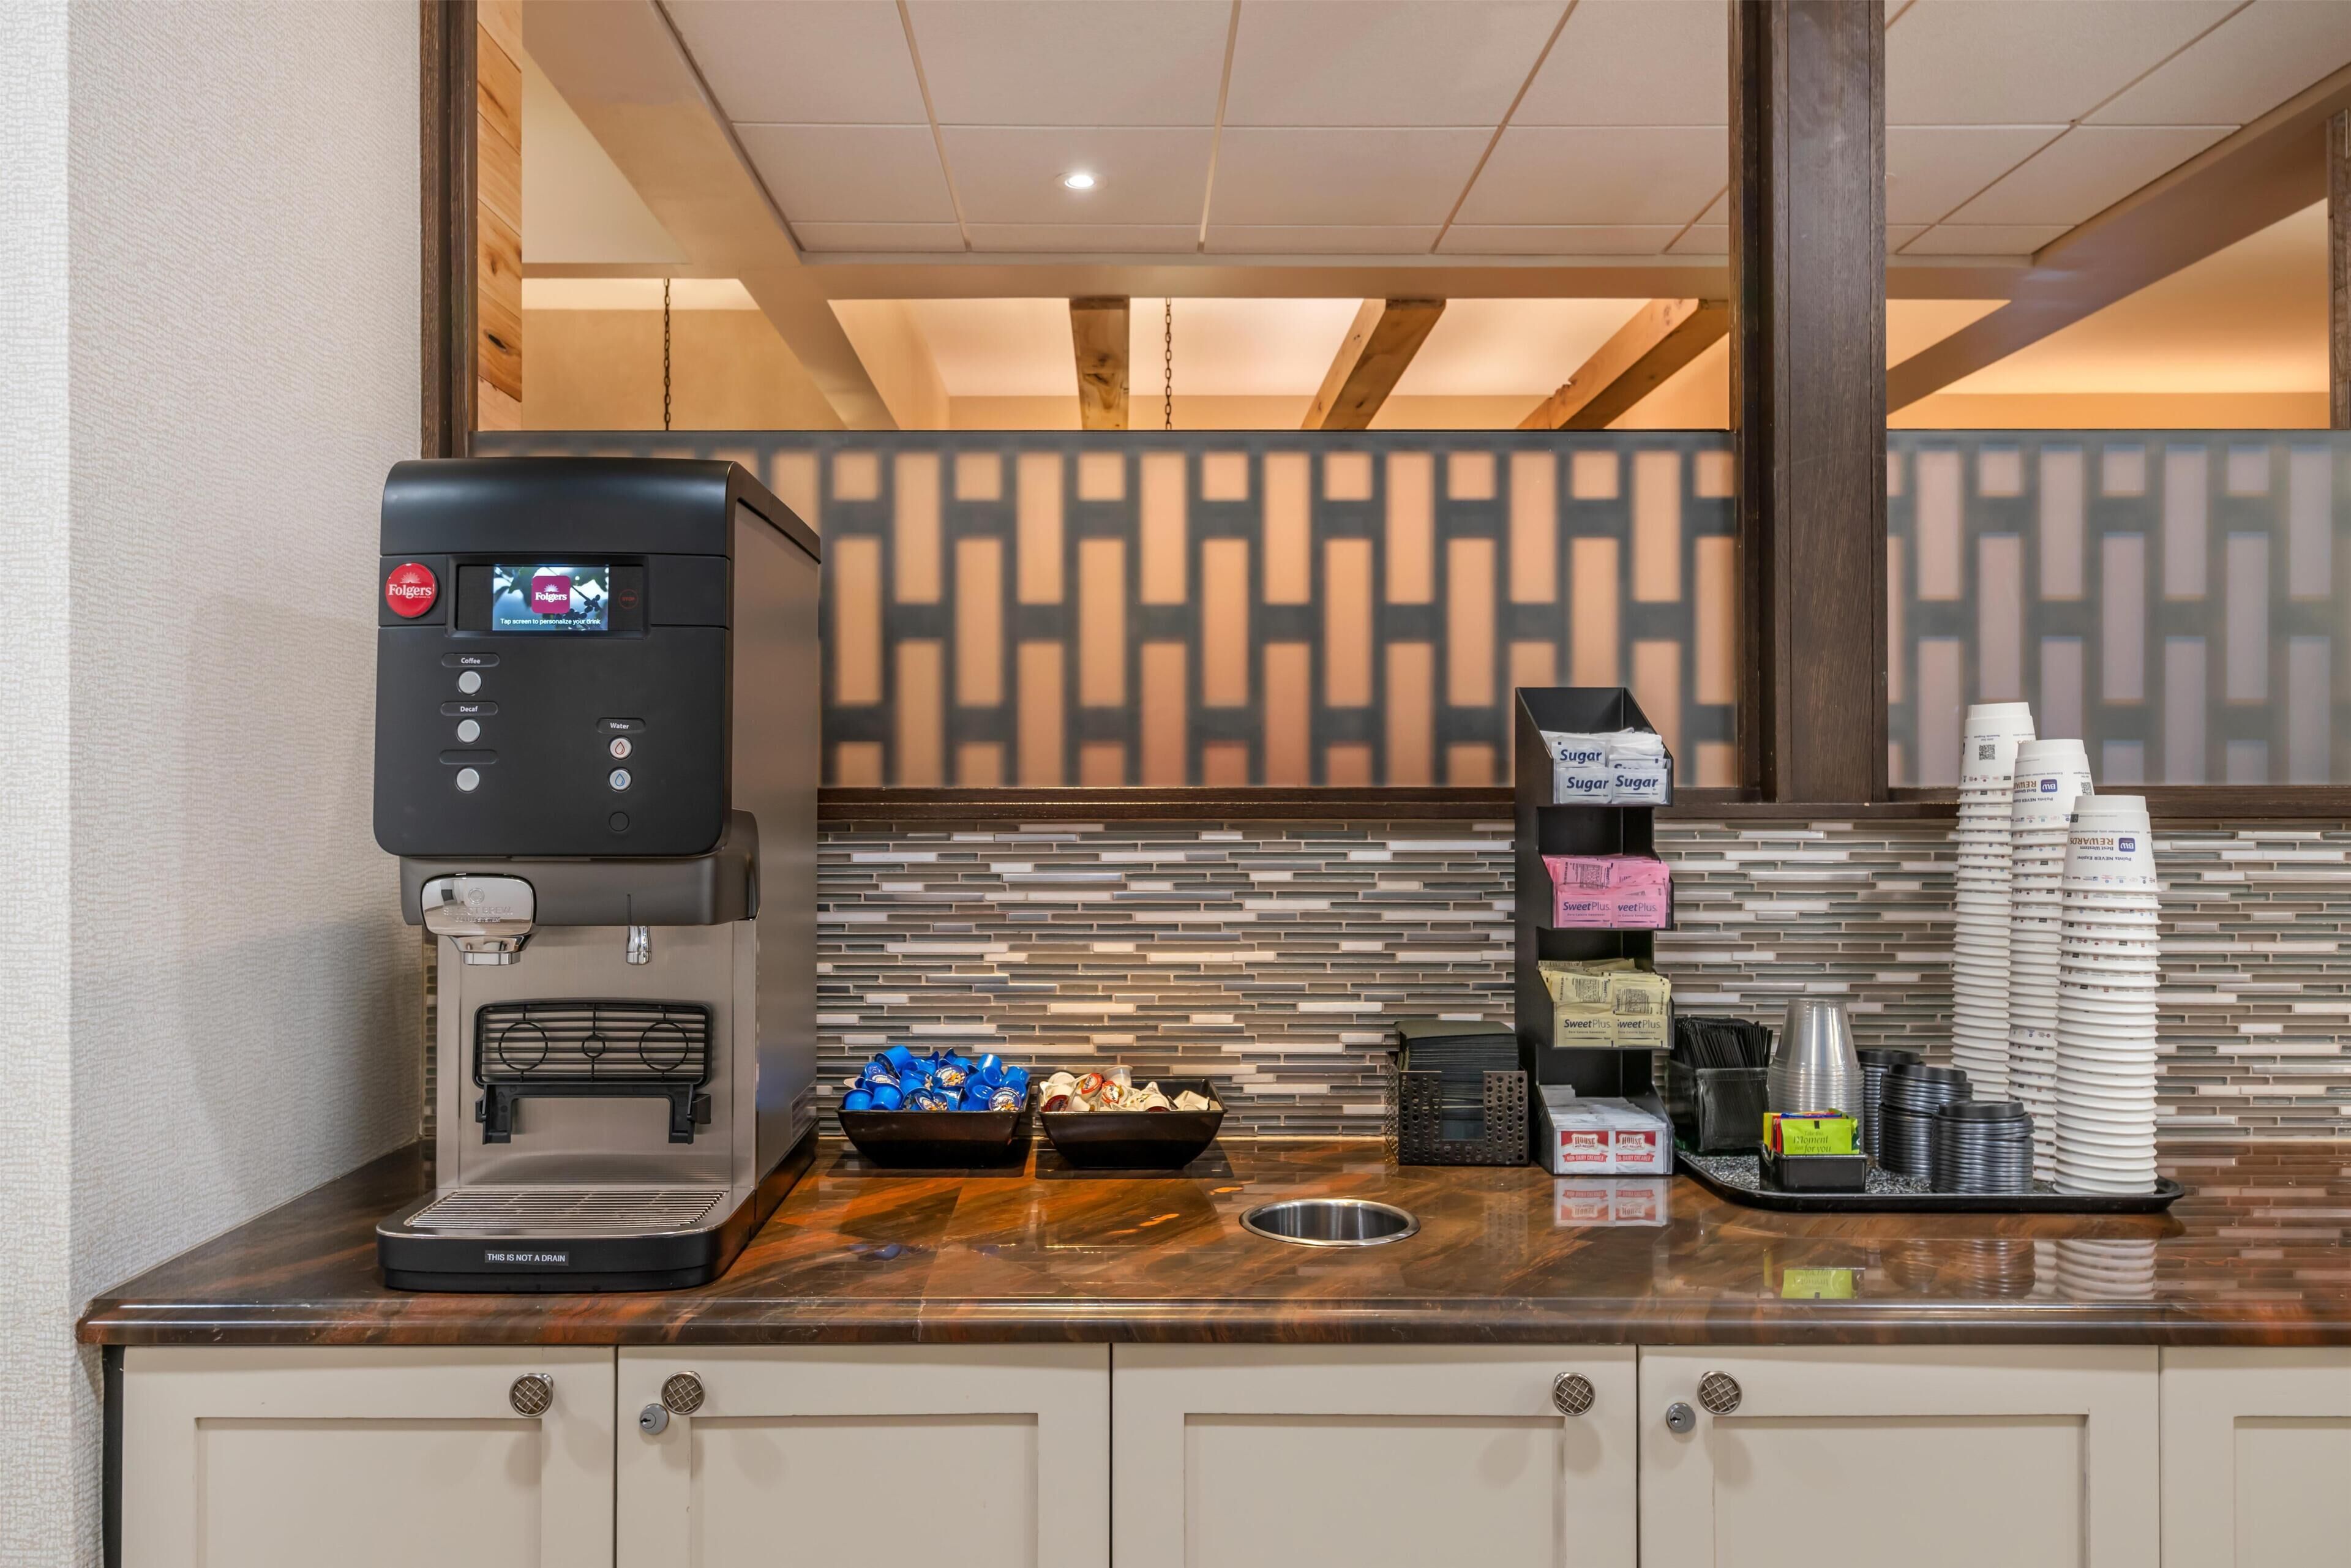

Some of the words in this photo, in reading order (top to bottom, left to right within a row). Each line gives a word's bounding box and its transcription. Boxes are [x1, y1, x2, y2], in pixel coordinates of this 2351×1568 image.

[388, 583, 432, 599] Folgers
[534, 592, 568, 602] Folgers
[1559, 749, 1602, 764] Sugar
[1567, 776, 1609, 792] Sugar
[1615, 775, 1659, 790] Sugar
[1575, 1136, 1595, 1145] HOUSE
[1622, 1136, 1643, 1145] HOUSE
[1793, 1135, 1828, 1144] Moment
[1804, 1144, 1816, 1154] for
